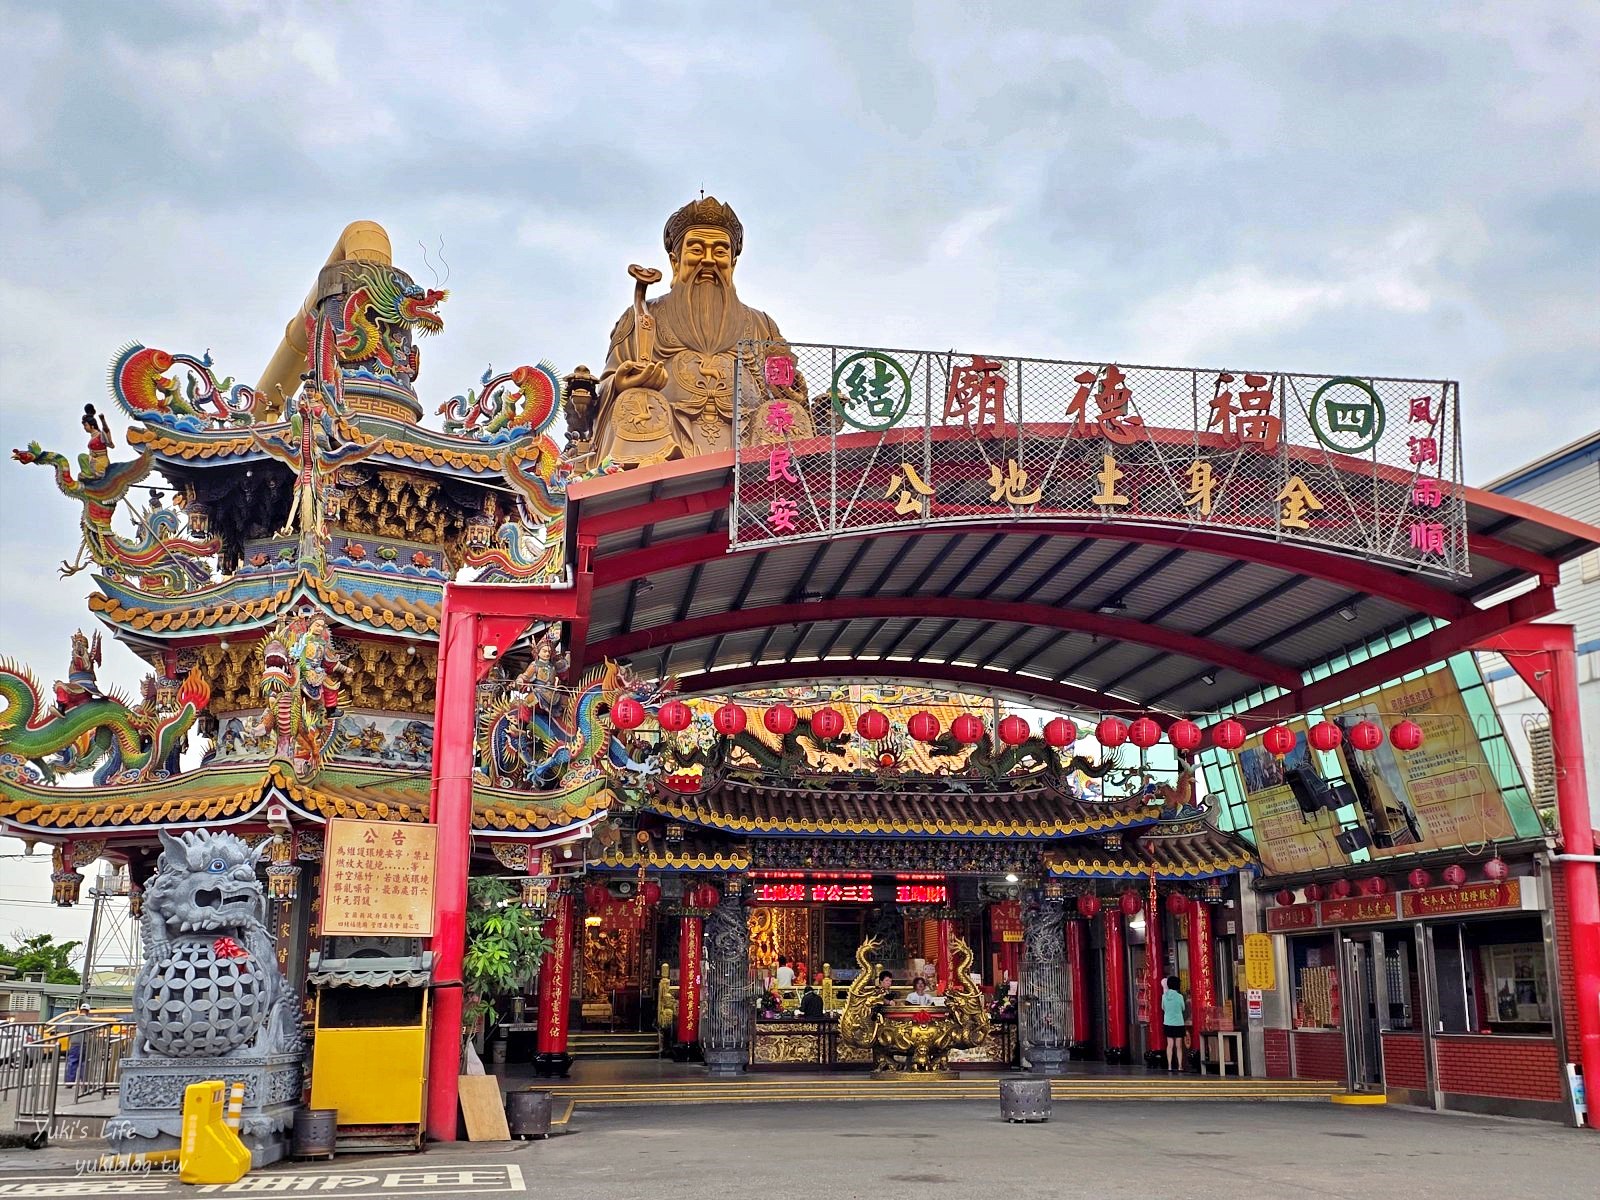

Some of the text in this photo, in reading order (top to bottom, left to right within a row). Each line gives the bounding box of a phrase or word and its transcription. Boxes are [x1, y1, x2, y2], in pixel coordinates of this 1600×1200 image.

[846, 352, 893, 416] 結
[765, 355, 799, 532] 國泰民安
[1326, 399, 1375, 437] 四
[1407, 396, 1446, 556] 風調雨順
[363, 828, 406, 846] 公告
[812, 885, 874, 902] 古公三王
